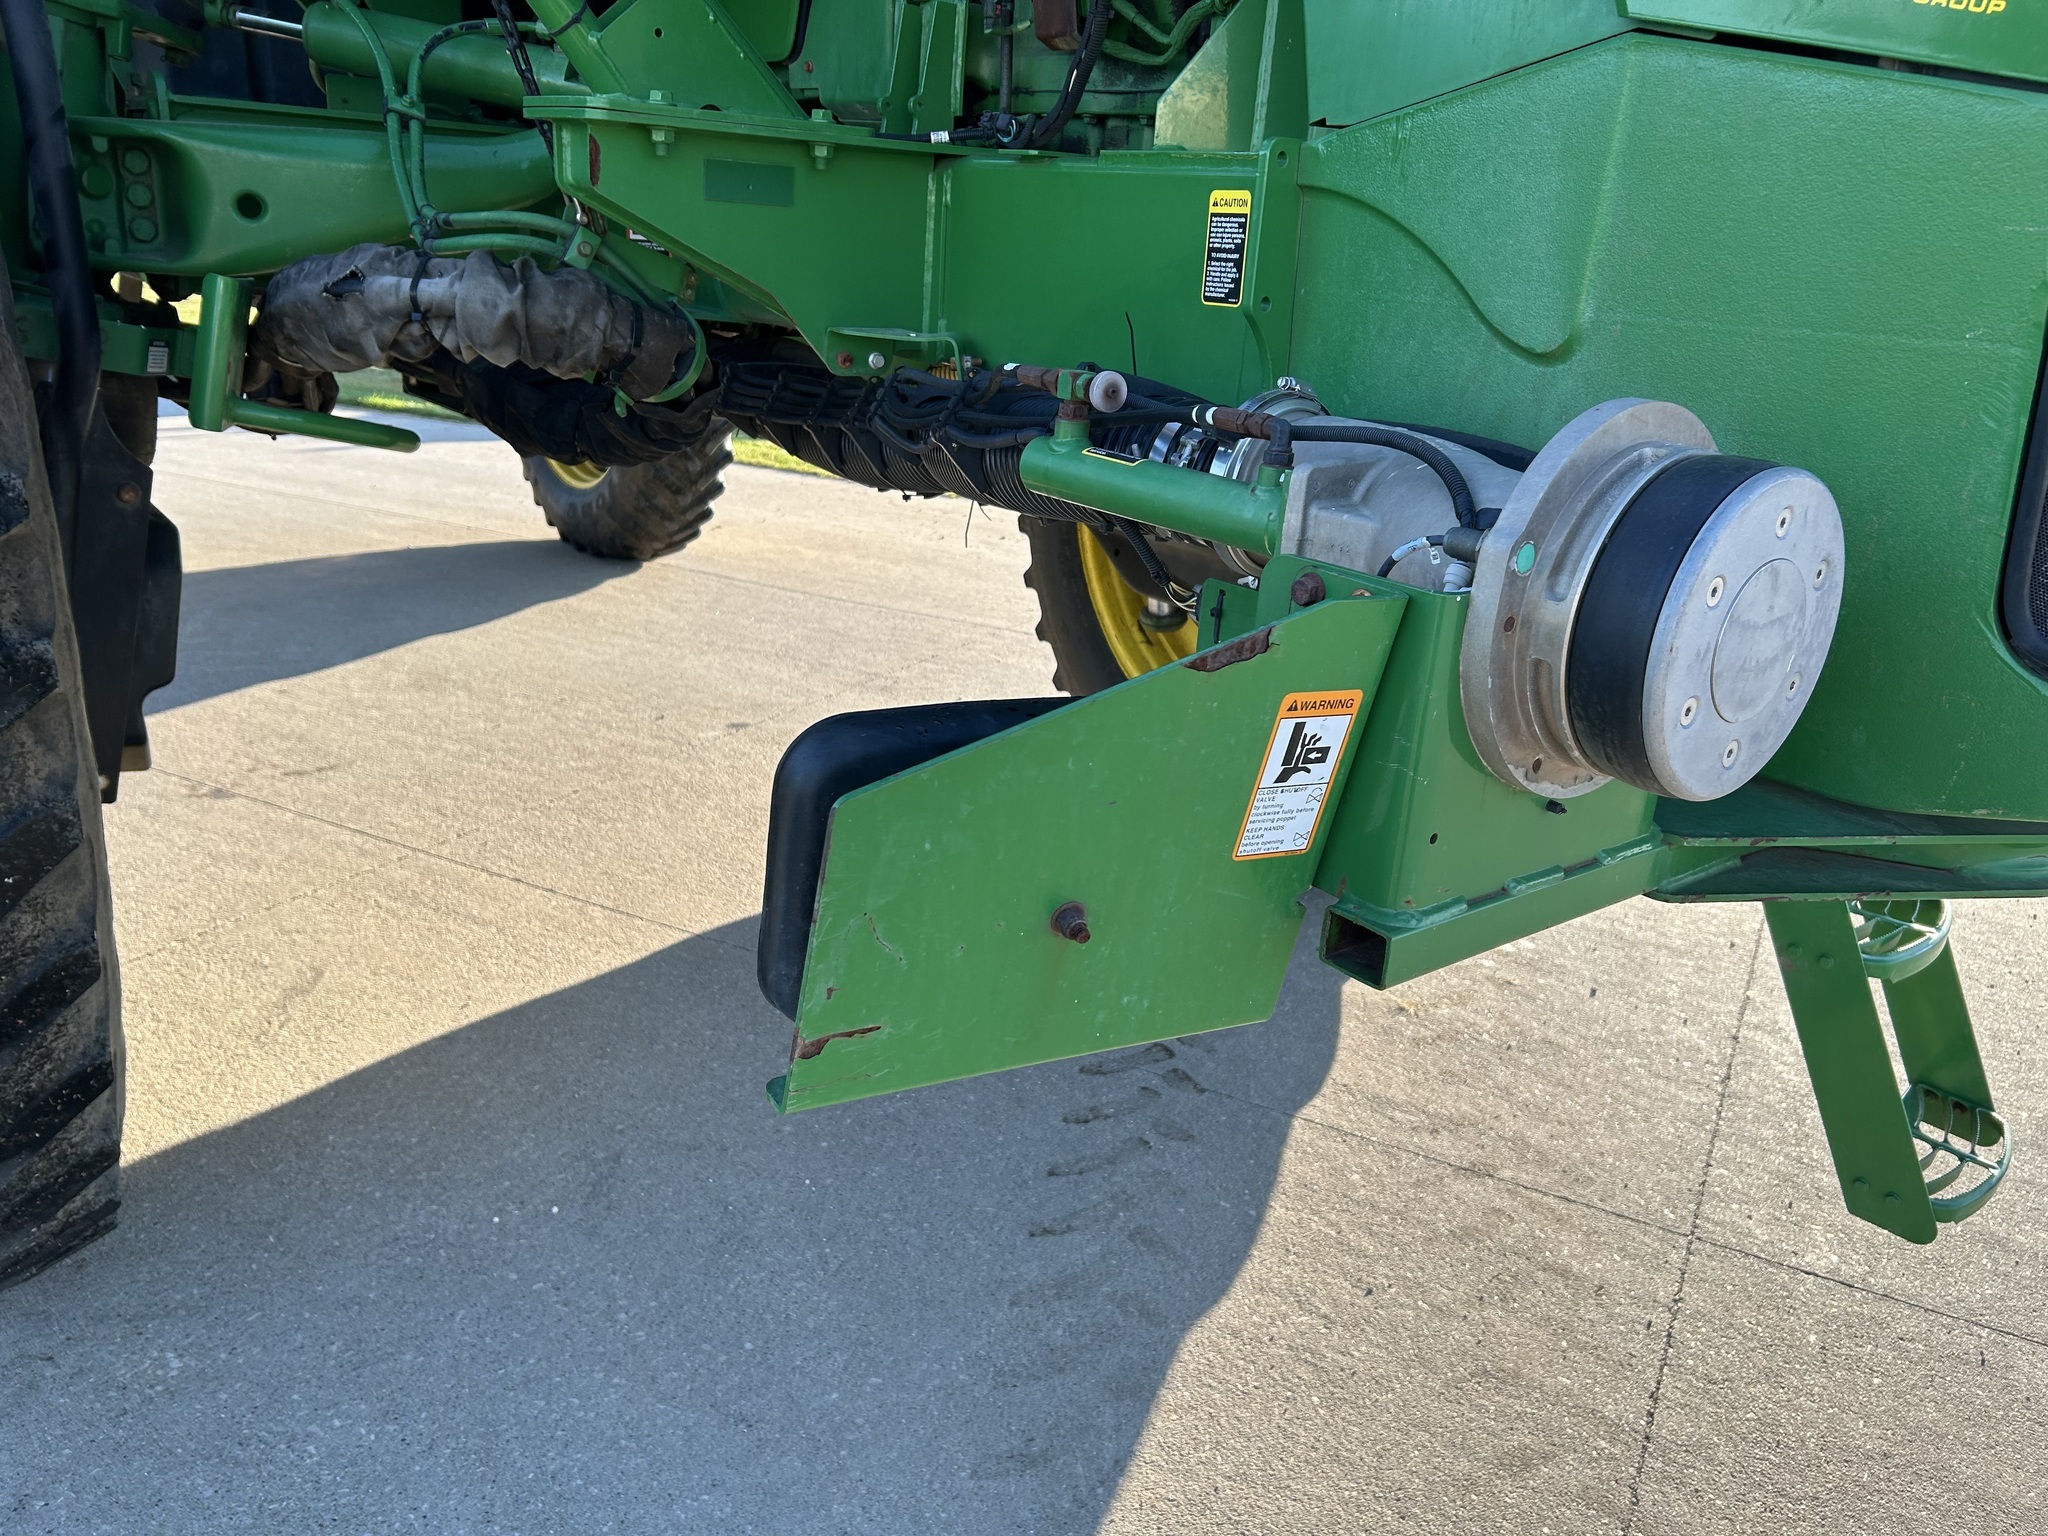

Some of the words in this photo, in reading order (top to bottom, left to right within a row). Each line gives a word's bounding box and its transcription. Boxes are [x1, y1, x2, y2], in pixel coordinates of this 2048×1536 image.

[1913, 0, 2006, 14] OUP
[1220, 198, 1248, 207] CAUTION
[1300, 698, 1354, 710] WARNING
